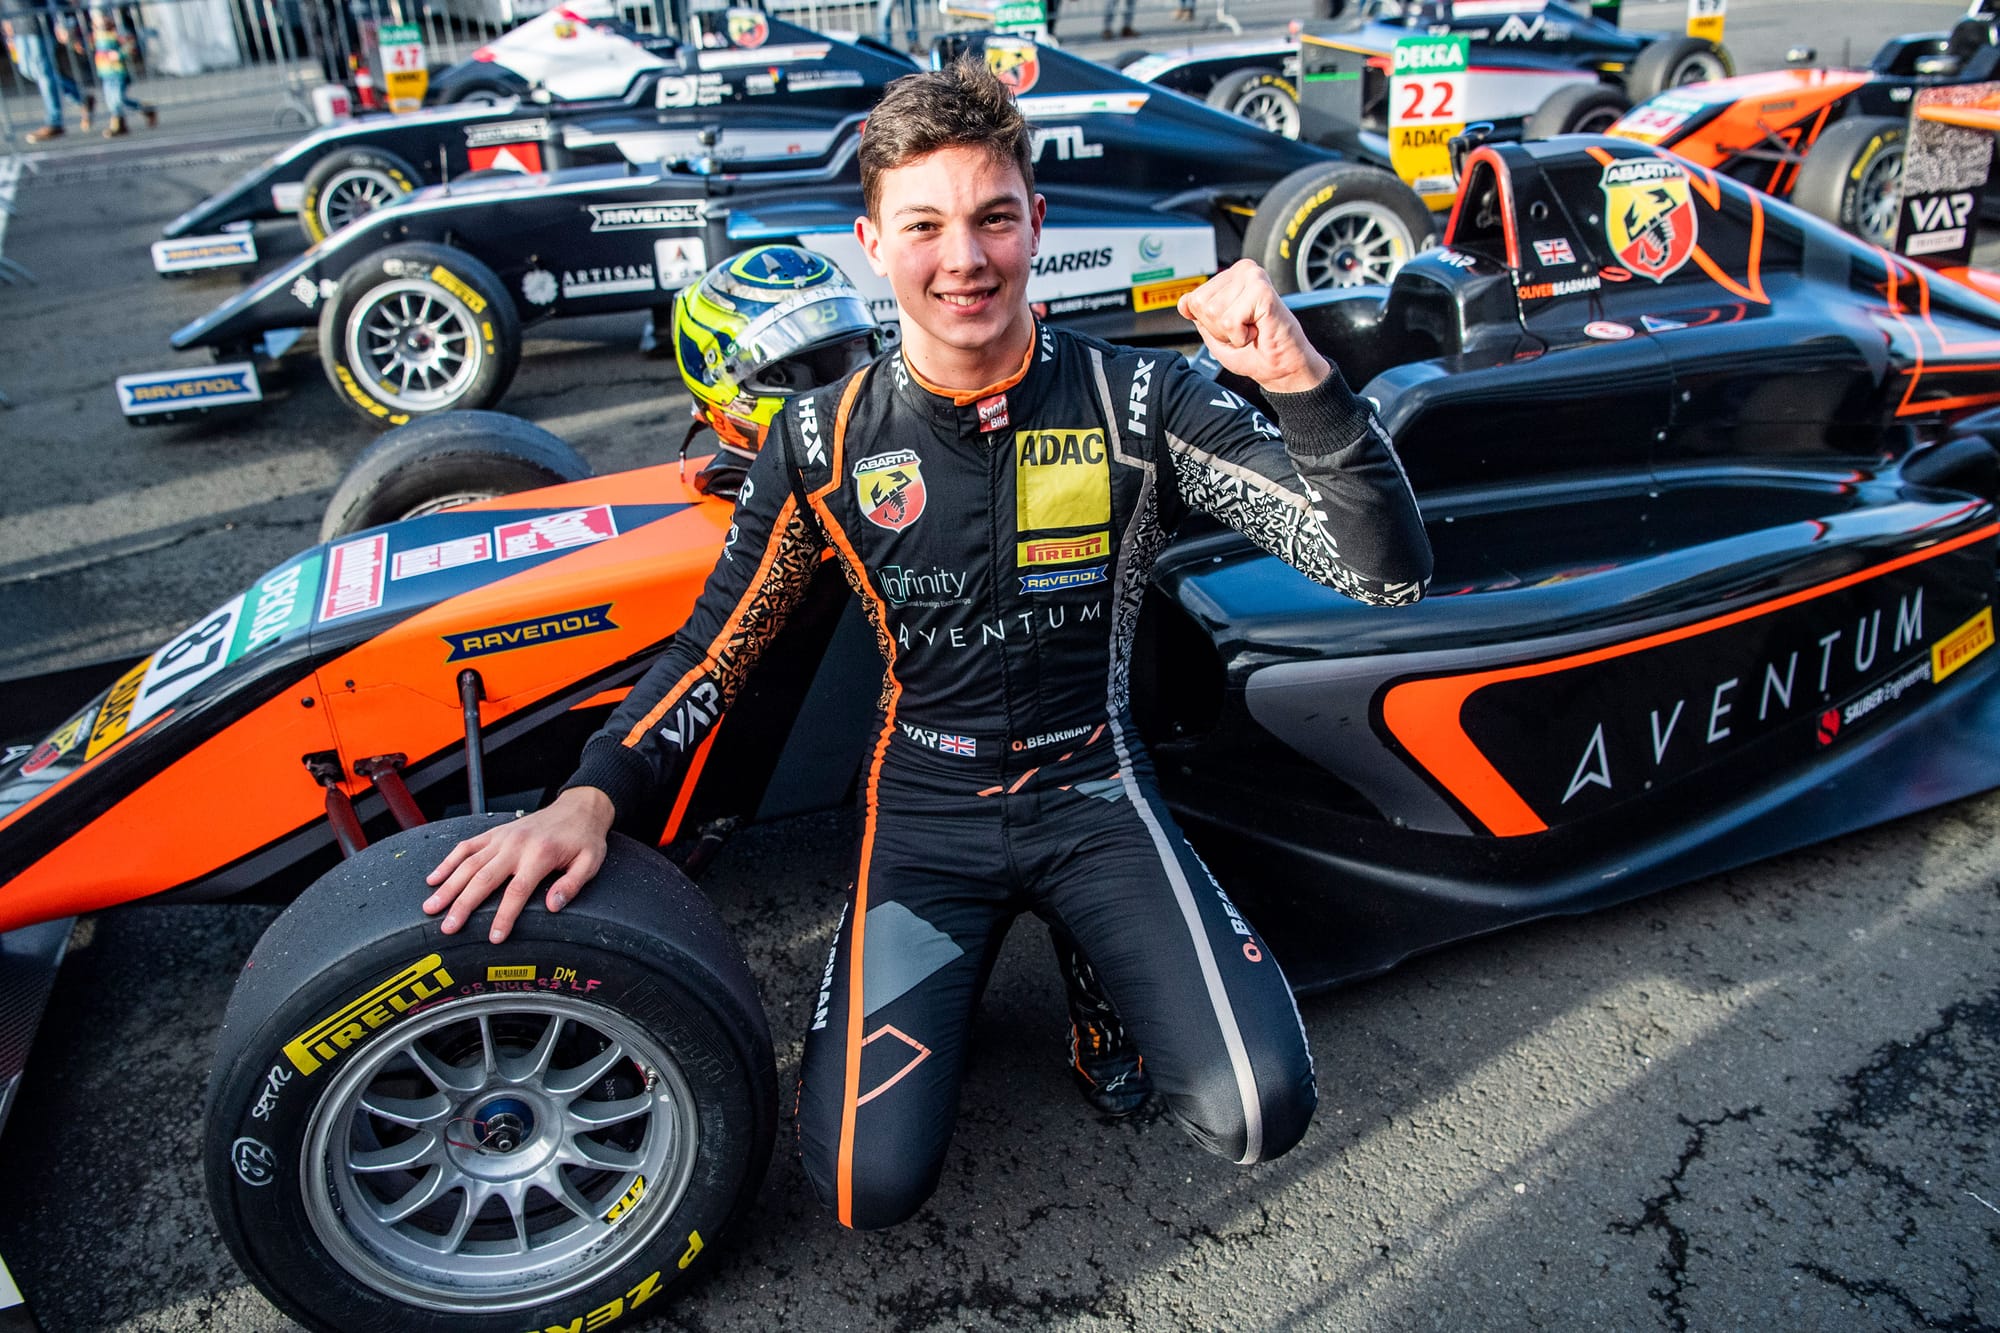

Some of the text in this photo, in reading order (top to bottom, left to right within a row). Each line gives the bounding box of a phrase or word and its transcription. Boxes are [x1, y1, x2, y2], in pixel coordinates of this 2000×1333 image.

[1394, 44, 1465, 69] DEKRA
[1401, 82, 1454, 119] 22
[1402, 129, 1450, 147] ADAC
[1607, 163, 1681, 184] ABARTH
[602, 206, 695, 225] RAVENOL
[1910, 192, 1974, 231] VAR
[562, 263, 654, 286] ARTISAN
[1031, 246, 1113, 277] HARRIS
[133, 378, 242, 401] RAVENOL
[1128, 357, 1156, 436] HRX
[1210, 390, 1246, 410] VA
[979, 396, 1008, 423] Sport
[990, 414, 1008, 429] Bild
[799, 396, 828, 467] HRX
[859, 454, 914, 472] ABARTH
[1020, 433, 1104, 467] ADAC
[1027, 536, 1102, 562] PIRELLI
[881, 566, 967, 597] Infinity
[1028, 571, 1100, 588] RAVENOL
[244, 563, 302, 653] DEKRA
[462, 614, 600, 652] RAVENOL
[898, 601, 1101, 650] AVENTUM
[144, 612, 232, 699] 87
[1938, 618, 1988, 672] PIRELLI
[92, 669, 147, 742] ADAC
[1561, 586, 1924, 804] AVENTUM
[1843, 660, 1932, 725] SAUBER Engineering
[660, 681, 719, 753] VAR
[898, 721, 939, 749] VAR
[1011, 724, 1093, 752] O.BEARMAN
[553, 967, 577, 982] DM
[282, 953, 455, 1077] PIRELLI
[608, 1175, 647, 1226] ATS
[677, 1229, 705, 1270] P
